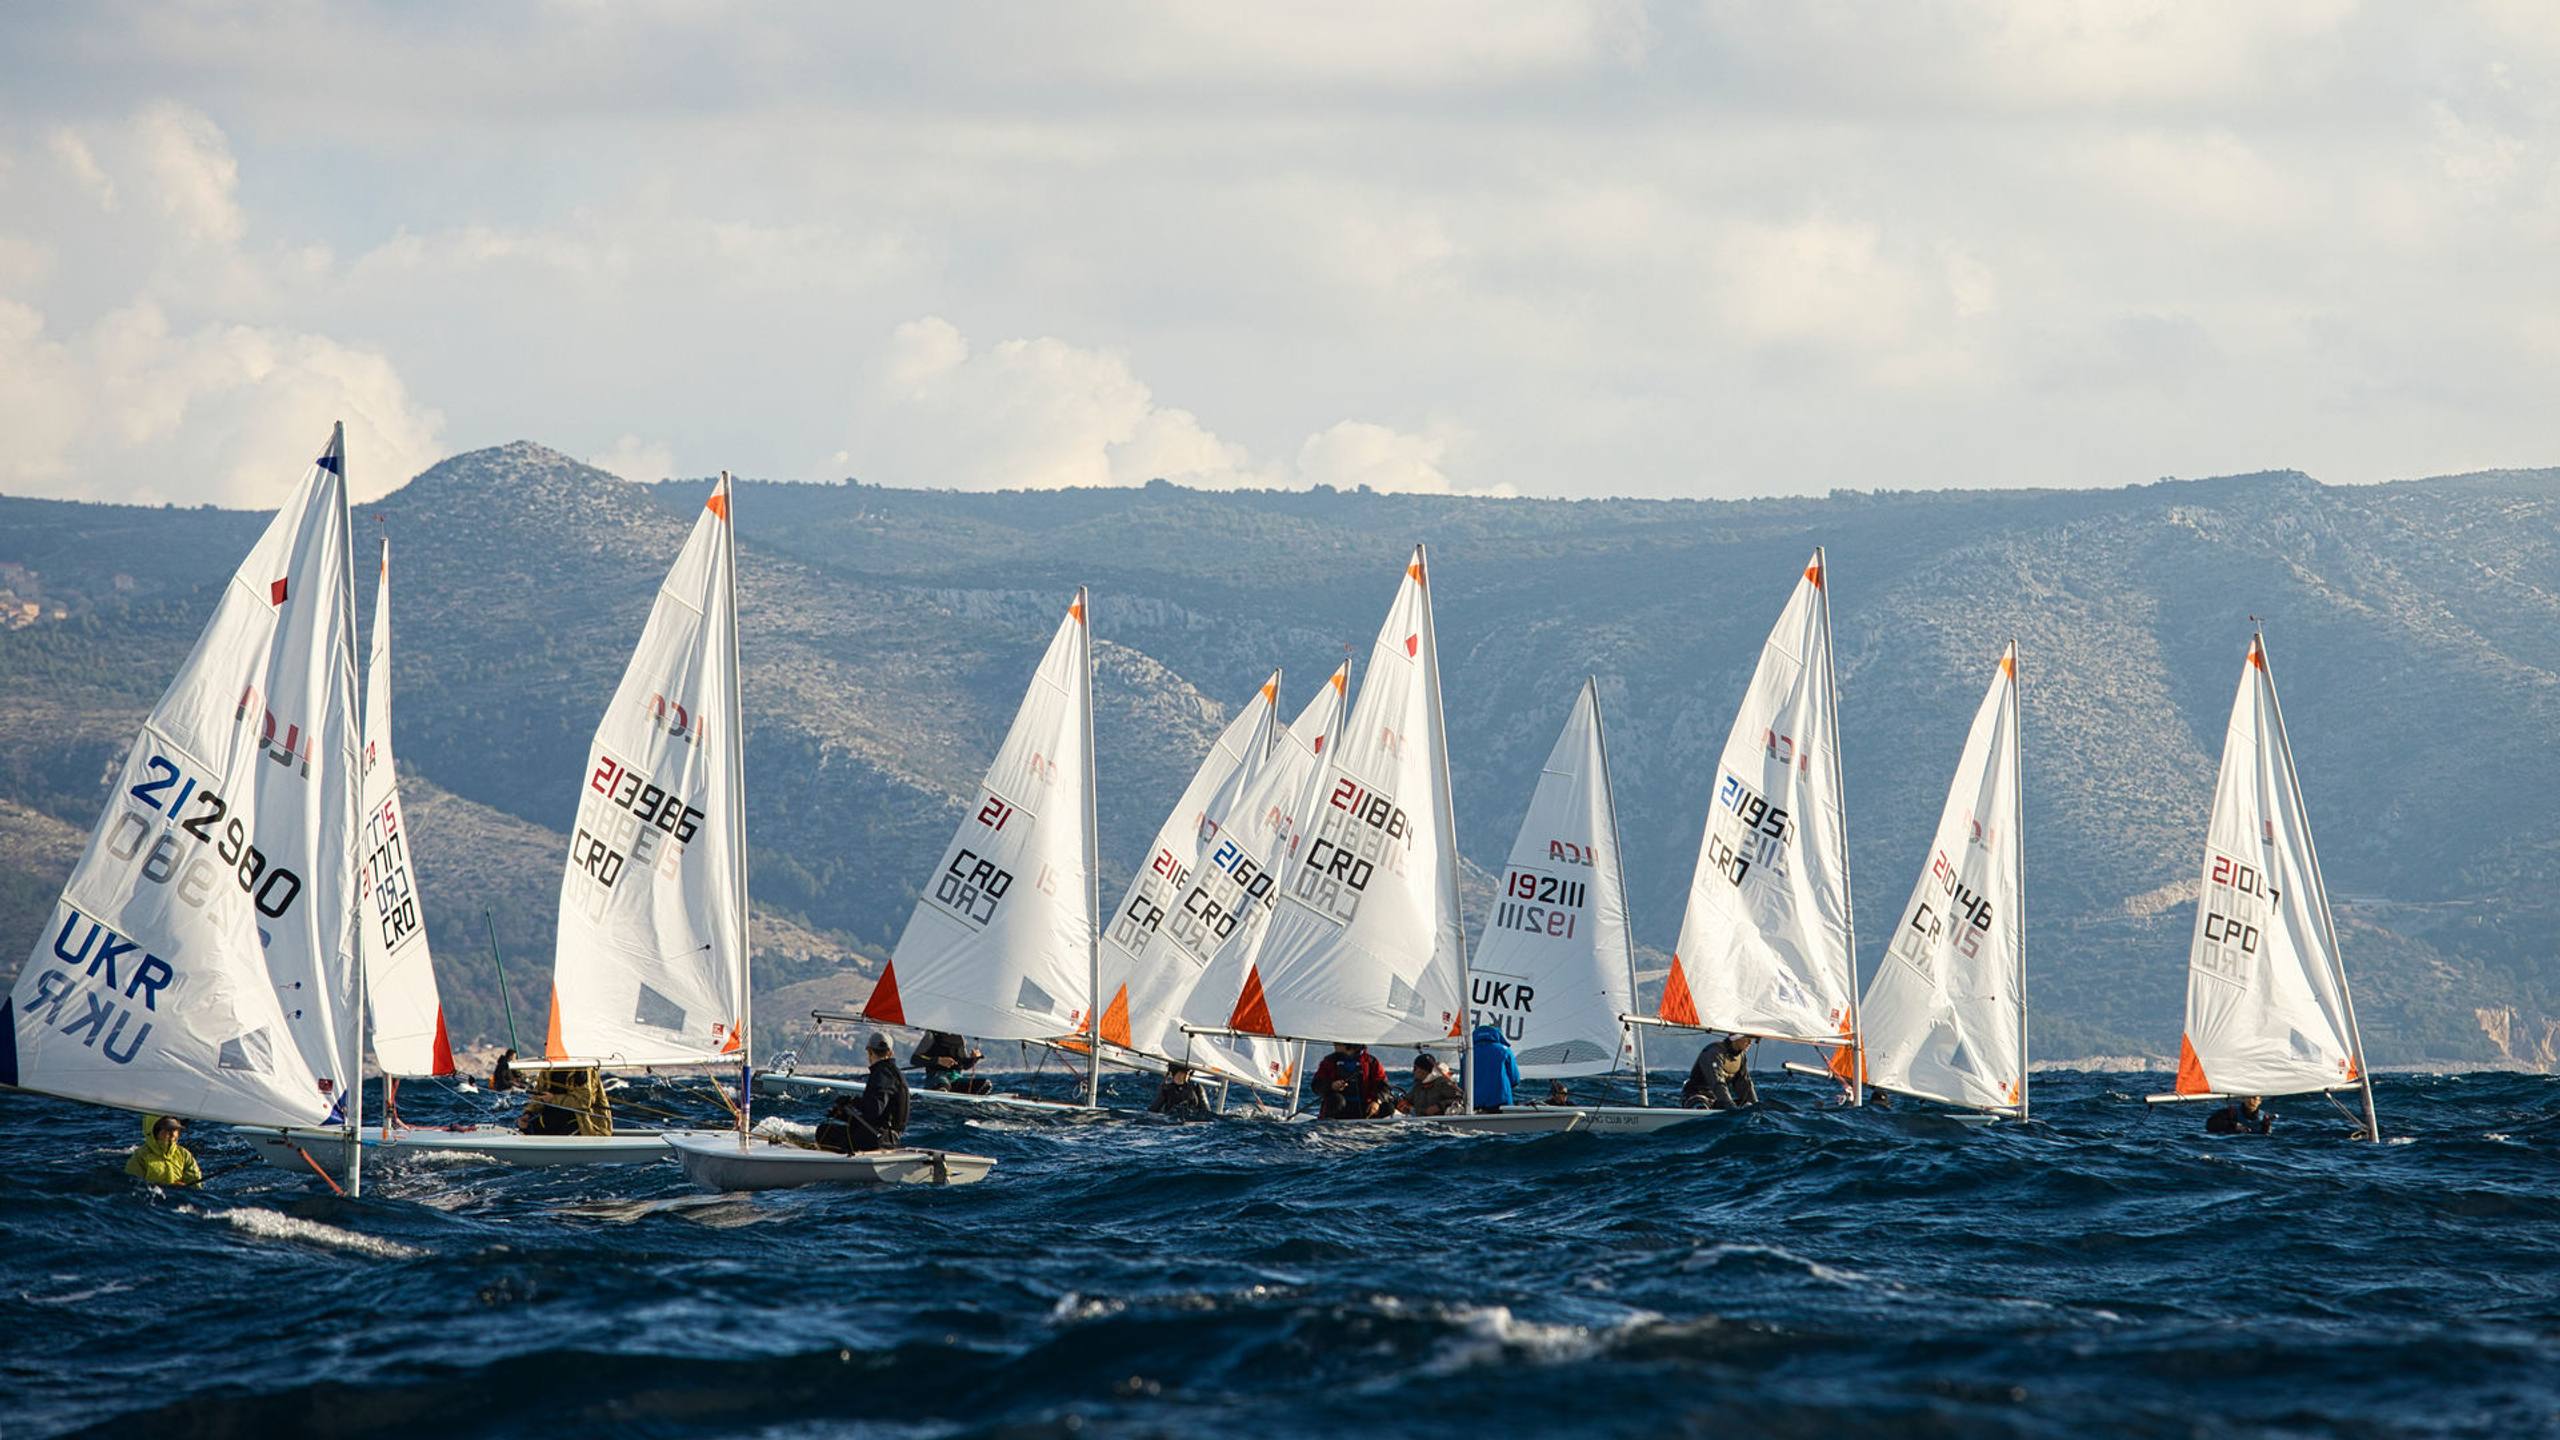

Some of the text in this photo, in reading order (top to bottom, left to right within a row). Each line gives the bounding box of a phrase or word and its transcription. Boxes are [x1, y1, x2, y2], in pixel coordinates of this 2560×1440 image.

[591, 756, 705, 844] 213986
[976, 796, 1013, 832] 21
[1329, 777, 1414, 851] 211884
[130, 755, 301, 919] 212980
[572, 827, 625, 888] CRO
[1708, 832, 1751, 888] CRO
[948, 848, 1014, 899] CRO
[1306, 837, 1375, 892] CRO
[1507, 871, 1586, 908] 192111
[381, 896, 416, 950] CRO
[1126, 894, 1165, 933] CR
[1184, 886, 1238, 940] CRO
[1911, 902, 1943, 947] CR
[53, 910, 174, 1012] UKR
[1471, 978, 1535, 1013] UKR
